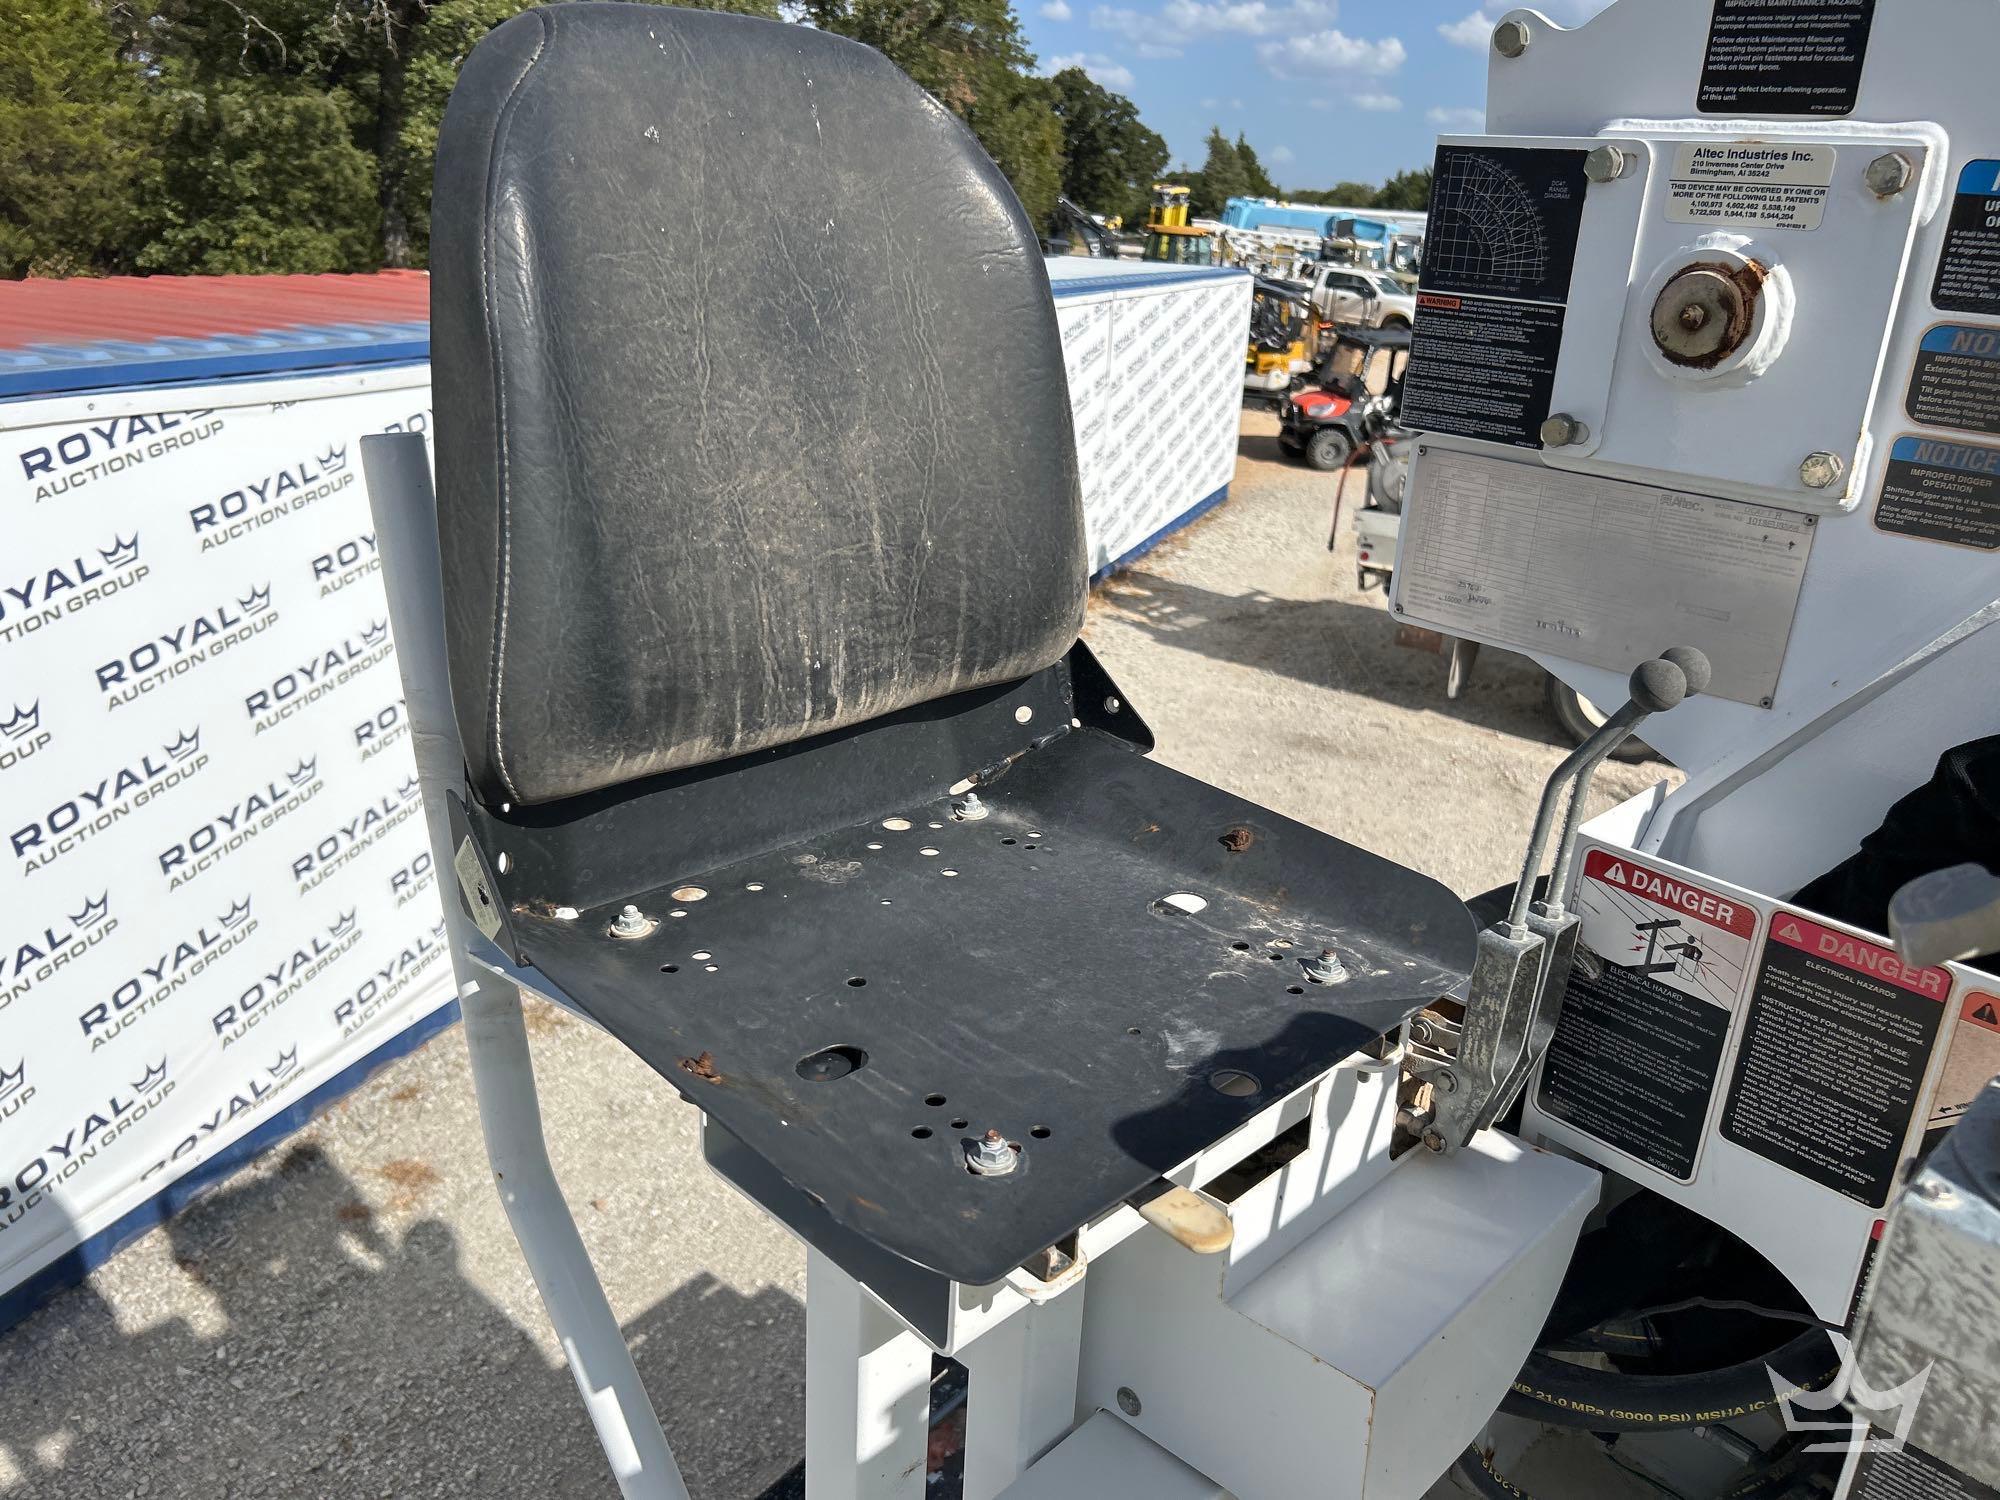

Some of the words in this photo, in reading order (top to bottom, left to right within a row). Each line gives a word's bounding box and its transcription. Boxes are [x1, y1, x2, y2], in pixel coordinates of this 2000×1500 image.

[1703, 85, 1724, 93] Repair
[1726, 86, 1737, 94] any
[1738, 85, 1759, 93] defect
[1783, 86, 1811, 94] allowing
[1690, 168, 1736, 178] Birmingham,
[1694, 148, 1724, 159] Altec
[1727, 149, 1788, 160] Industries
[1791, 151, 1814, 162] Inc.
[1722, 193, 1767, 202] FOLLOWING
[1745, 186, 1782, 194] COVERED
[1426, 297, 1457, 307] WARNING
[1922, 375, 1940, 384] may
[1941, 377, 1968, 386] cause
[1924, 363, 1968, 378] Extending
[1969, 370, 1994, 378] boom
[19, 412, 182, 480] ROYAL
[35, 448, 144, 503] AUCTION
[147, 419, 225, 458] GROUP
[1910, 468, 1957, 482] IMPROPER
[1957, 474, 1992, 488] DIGGER
[1914, 441, 1999, 472] NOTICE
[189, 463, 321, 534] ROYAL
[201, 503, 290, 553] AUCTION
[292, 473, 355, 511] GROUP
[1883, 493, 1899, 502] may
[1901, 495, 1923, 505] cause
[1924, 499, 1954, 511] damage
[1965, 506, 1983, 514] unit.
[1922, 479, 1973, 494] OPERATION
[0, 557, 104, 621] YAL
[311, 532, 377, 581] ROY
[320, 557, 382, 600] AUCTIO
[0, 604, 62, 643] TION
[66, 565, 151, 613] GROUP
[95, 606, 241, 693] ROYAL
[108, 649, 206, 713] AUCTION
[209, 611, 280, 657] GROUP
[245, 640, 363, 720] ROYAL
[254, 679, 335, 736] AUCTION
[337, 643, 394, 686] GROUP
[9, 756, 168, 858] ROYAL
[24, 802, 130, 878] AUCTION
[134, 753, 209, 808] GROUP
[158, 783, 289, 876] ROYAL
[169, 821, 258, 893] AUCTION
[261, 779, 324, 830] GROUP
[292, 797, 400, 882] ROYAL
[299, 833, 374, 898] AUCTION
[1632, 869, 1734, 925] DANGER
[36, 917, 119, 983] GROUP
[78, 928, 222, 1037] ROYAL
[333, 935, 433, 1026] ROYAL
[1805, 960, 1855, 984] ELECTRICAL
[1856, 979, 1897, 999] HAZARDS
[1818, 933, 1941, 994] DANGER
[91, 972, 188, 1054] AUCTION
[190, 919, 259, 978] GROUP
[212, 936, 331, 1036] ROYAL
[222, 976, 302, 1051] AUCTION
[304, 929, 363, 984] GROUP
[342, 974, 410, 1039] AUCTION
[1609, 965, 1651, 989] ELECTRICAL
[1652, 983, 1683, 1002] HAZARD
[1765, 972, 1795, 988] contact
[1796, 984, 1813, 995] with
[1815, 991, 1830, 1001] this
[1831, 998, 1877, 1020] equipment
[1889, 1021, 1920, 1036] vehicle
[1767, 964, 1790, 977] Death
[1802, 979, 1832, 994] serious
[1834, 990, 1858, 1005] injury
[1860, 1000, 1875, 1010] will
[1876, 1008, 1901, 1021] result
[1902, 1016, 1923, 1030] from
[1778, 985, 1805, 999] should
[1807, 996, 1839, 1012] become
[1840, 1009, 1886, 1031] electrically
[1887, 1028, 1925, 1046] charged.
[1760, 994, 1819, 1022] INSTRUCTIONS
[1820, 1018, 1838, 1031] FOR
[1839, 1025, 1888, 1051] INSULATING
[1890, 1046, 1910, 1059] USE:
[1760, 1010, 1783, 1023] winch
[1785, 1021, 1800, 1031] line
[1801, 1027, 1821, 1039] from
[1822, 1035, 1846, 1049] upper
[1848, 1045, 1874, 1060] boom.
[1761, 1002, 1786, 1017] Winch
[1787, 1013, 1802, 1022] line
[1812, 1024, 1827, 1033] not
[1829, 1029, 1870, 1051] insulating.
[1873, 1048, 1909, 1066] Remove
[100, 1080, 177, 1148] GROUP
[1536, 1390, 1568, 1407] 21.0
[1571, 1401, 1605, 1416] MPa
[1610, 1408, 1654, 1422] (3000
[1658, 1412, 1691, 1422] PSI)
[1696, 1406, 1745, 1421] MSHA
